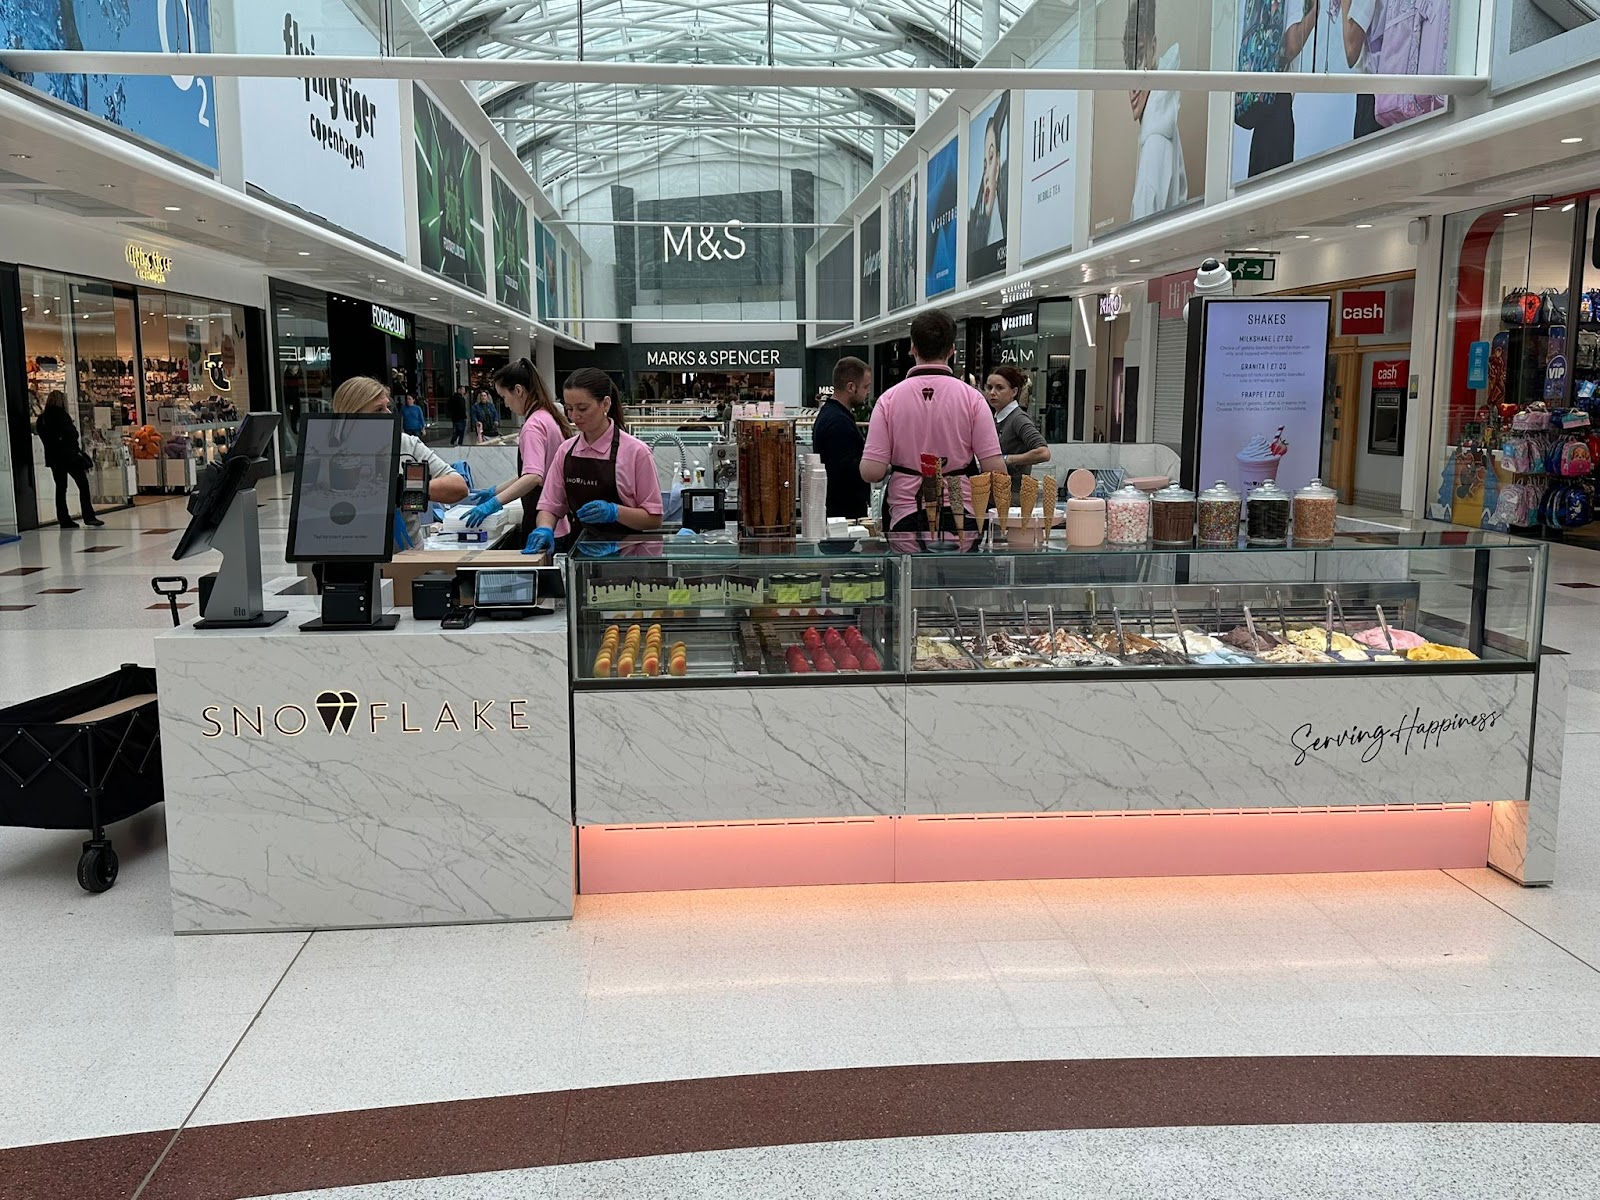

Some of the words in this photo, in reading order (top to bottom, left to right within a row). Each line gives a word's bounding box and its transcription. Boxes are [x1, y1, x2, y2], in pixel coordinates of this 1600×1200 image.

[339, 77, 377, 139] tiger
[309, 113, 365, 170] copenhagen
[1033, 116, 1045, 162] Hi
[1047, 105, 1070, 152] Tea
[663, 219, 746, 263] M&S
[1247, 313, 1286, 325] SHAKES
[1342, 303, 1383, 319] cash
[647, 351, 696, 366] MARKS
[697, 351, 708, 366] &
[710, 349, 781, 365] SPENCER
[1377, 365, 1398, 380] cash
[1549, 367, 1564, 379] VIP
[818, 386, 835, 395] M&S
[200, 690, 530, 738] SNOWFLAKE
[1291, 722, 1391, 766] Serving
[1389, 706, 1503, 756] Happiness
